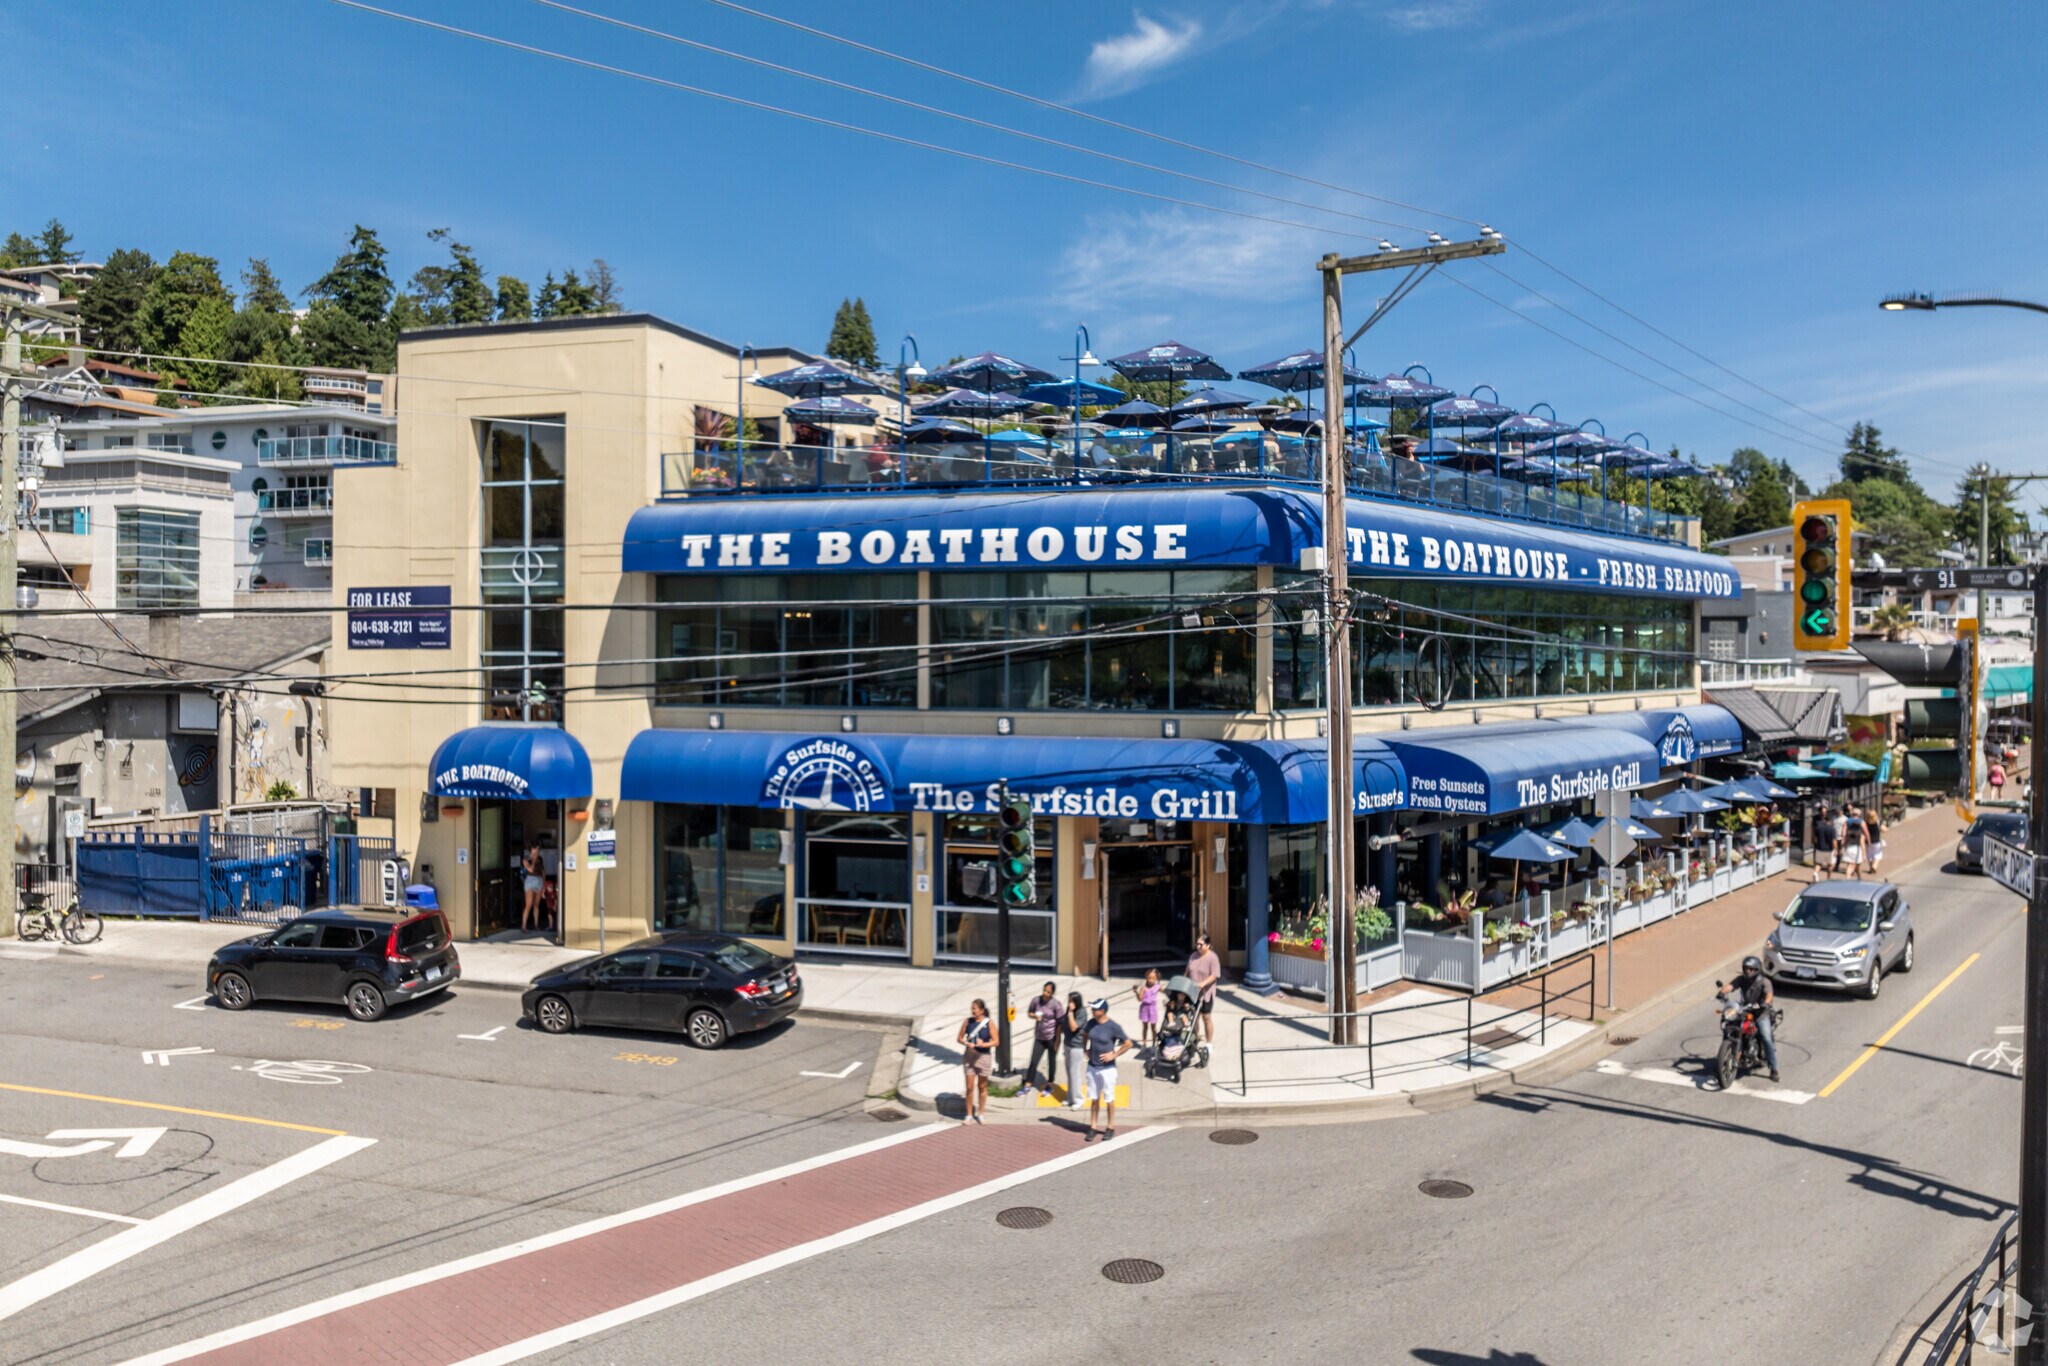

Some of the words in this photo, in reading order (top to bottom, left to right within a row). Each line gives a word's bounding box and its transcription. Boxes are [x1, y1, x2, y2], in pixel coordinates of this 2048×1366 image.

[681, 532, 791, 567] THE
[817, 524, 1188, 565] BOATHOUSE
[1347, 527, 1410, 567] THE
[1422, 536, 1569, 580] BOATHOUSE
[1598, 557, 1657, 590] FRESH
[1664, 567, 1733, 597] SEAFOOD
[351, 593, 373, 608] FOR
[376, 592, 412, 608] LEASE
[351, 620, 412, 634] 604-638-2121
[436, 767, 459, 790] THE
[462, 764, 529, 795] BOATHOUSE
[765, 765, 788, 798] The
[786, 739, 856, 767] Surfside
[857, 759, 885, 802] Grill
[1411, 776, 1437, 791] Free
[1439, 777, 1485, 795] Sunsets
[1517, 778, 1548, 807] The
[1551, 769, 1608, 802] Surfside
[1611, 761, 1641, 790] Grill
[447, 788, 512, 797] RESTAURANT
[909, 782, 975, 811] The
[1150, 788, 1239, 820] Grill
[1358, 789, 1404, 811] Sunsets
[1410, 793, 1442, 808] Fresh
[1444, 796, 1487, 813] Oysters
[1985, 838, 2007, 882] MARINE
[2010, 852, 2031, 894] DRIVE
